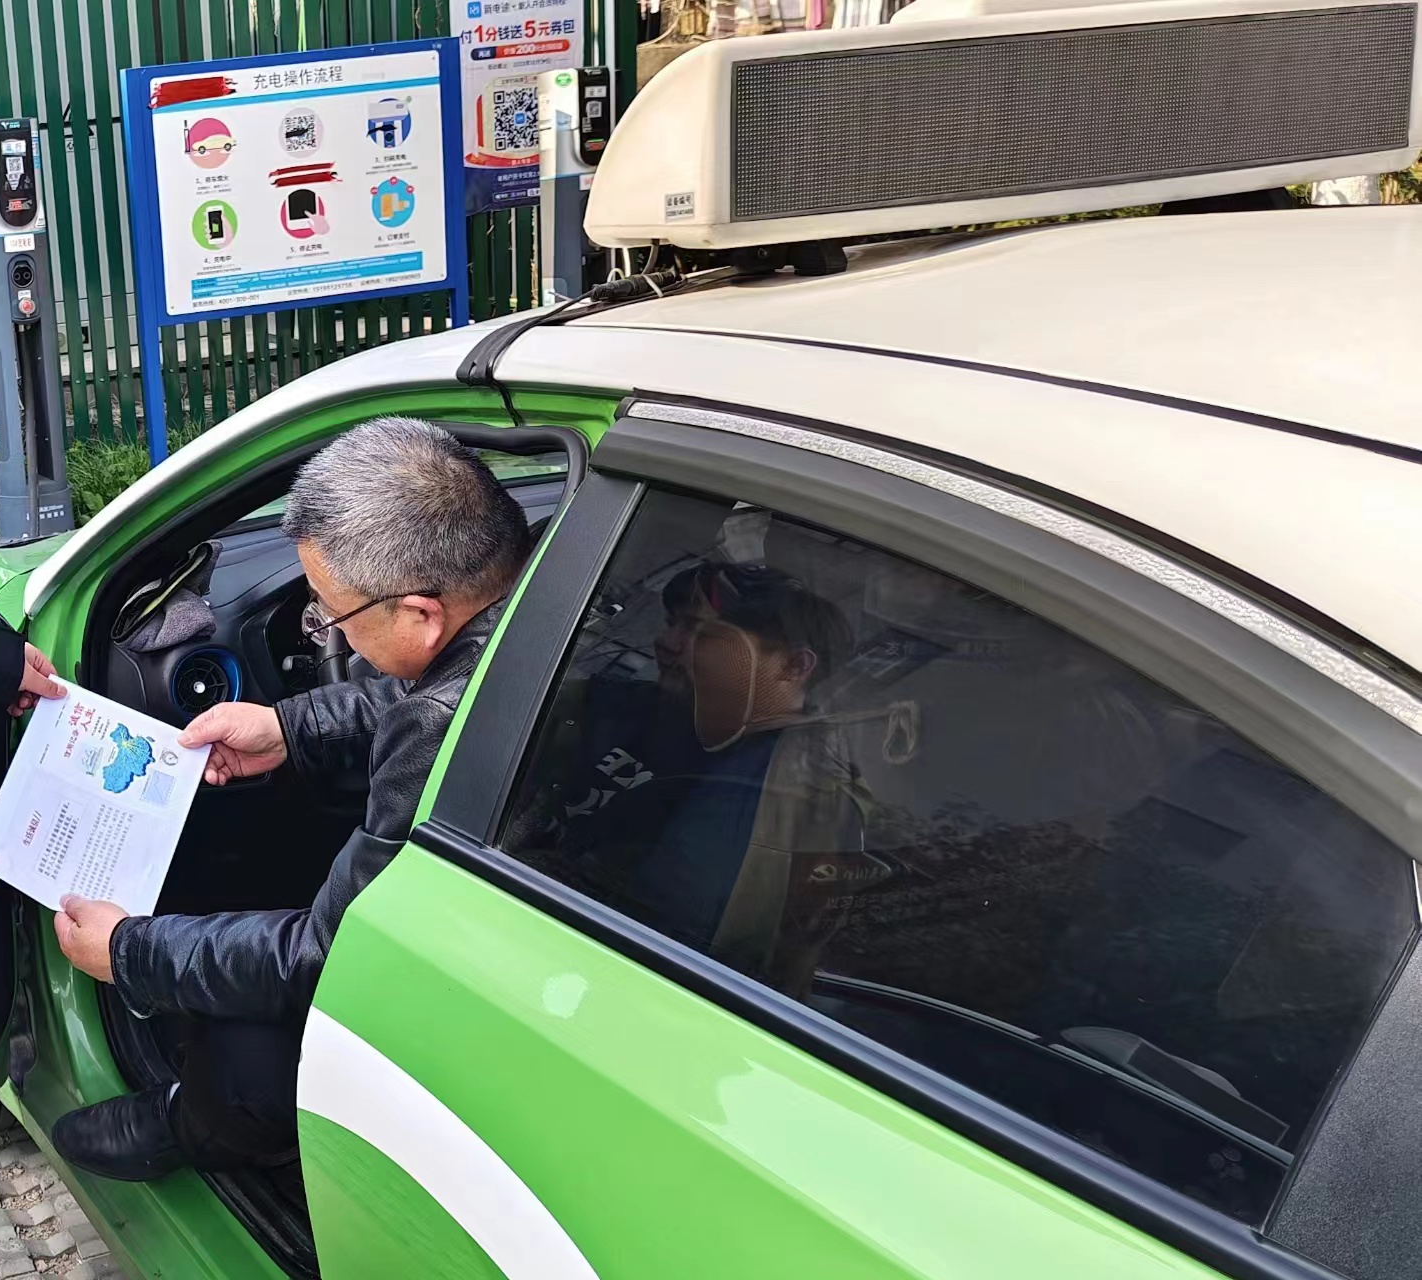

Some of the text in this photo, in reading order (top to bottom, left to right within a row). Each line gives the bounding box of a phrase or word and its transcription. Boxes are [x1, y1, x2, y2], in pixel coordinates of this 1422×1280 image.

[461, 19, 575, 44] 付1分钱送5元券包
[253, 65, 344, 90] 充电操作流程
